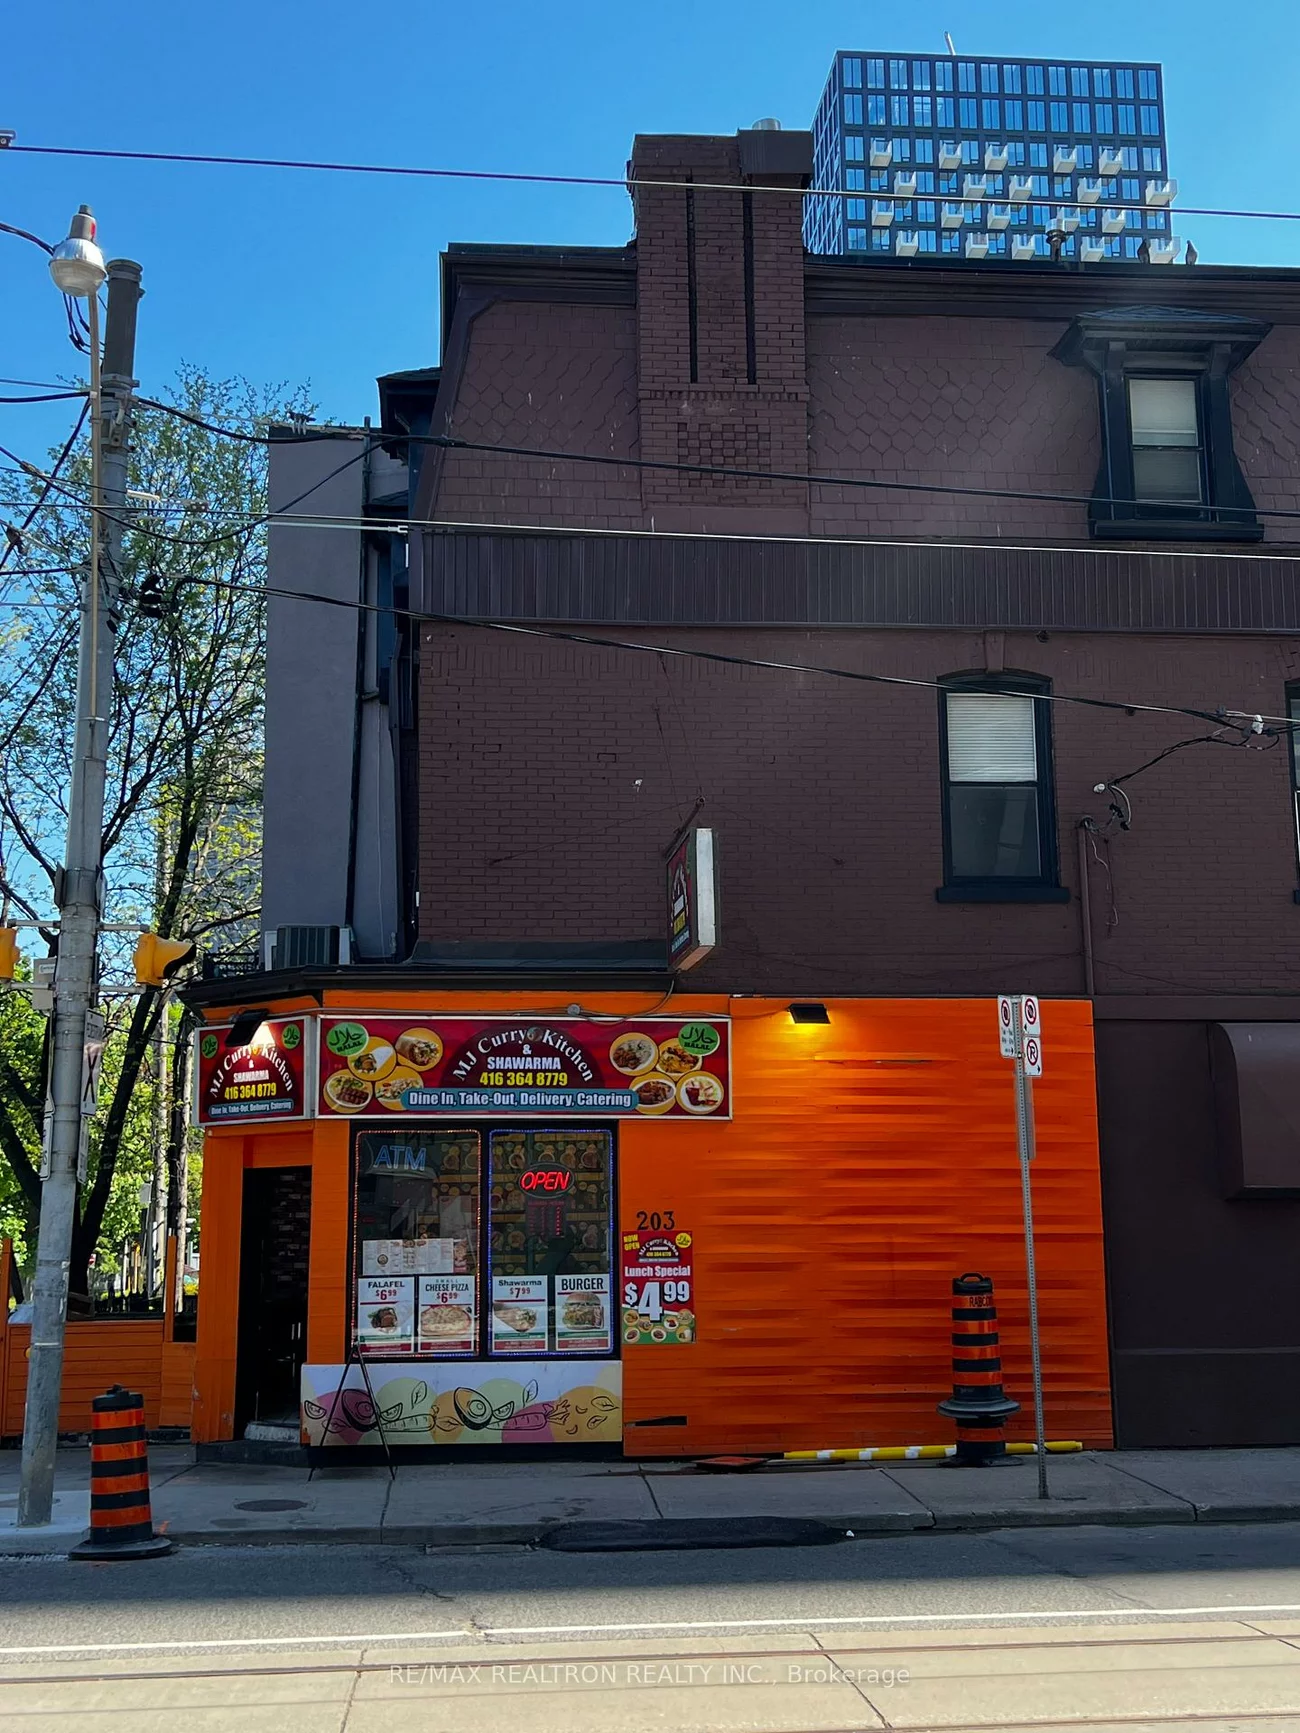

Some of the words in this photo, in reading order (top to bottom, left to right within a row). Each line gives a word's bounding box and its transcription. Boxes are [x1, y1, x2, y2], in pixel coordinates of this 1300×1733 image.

[329, 1027, 365, 1046] حلال
[681, 1026, 717, 1044] حلال
[336, 1041, 363, 1052] HALAL
[522, 1044, 532, 1055] &
[684, 1042, 710, 1050] HALAL
[452, 1051, 478, 1082] MJ
[477, 1027, 528, 1054] Curry
[542, 1028, 594, 1082] Kitchen
[487, 1056, 561, 1070] SHAWARMA
[210, 1069, 224, 1098] MJ
[223, 1044, 252, 1071] Curry
[261, 1043, 293, 1092] Kitchen
[233, 1069, 270, 1083] SHAWARMA
[479, 1072, 504, 1086] 416
[507, 1072, 534, 1086] 364
[536, 1072, 568, 1086] 8779
[224, 1086, 239, 1100] 416
[240, 1084, 255, 1098] 364
[257, 1082, 277, 1097] 8779
[270, 1101, 292, 1110] Catering
[409, 1092, 438, 1105] Dine
[441, 1092, 457, 1106] In,
[459, 1092, 518, 1106] Take-Out,
[520, 1092, 575, 1107] Delivery,
[577, 1092, 631, 1107] Catering
[373, 1145, 427, 1171] ATM
[521, 1171, 570, 1190] OPEN
[636, 1211, 675, 1231] 203
[623, 1234, 638, 1243] NOW
[624, 1242, 640, 1251] OPEN
[625, 1266, 653, 1277] Lunch
[654, 1265, 691, 1277] Special
[425, 1284, 450, 1292] CHEESE
[451, 1283, 469, 1291] PIZZA
[498, 1279, 542, 1287] Shawarma
[561, 1278, 604, 1291] BURGER
